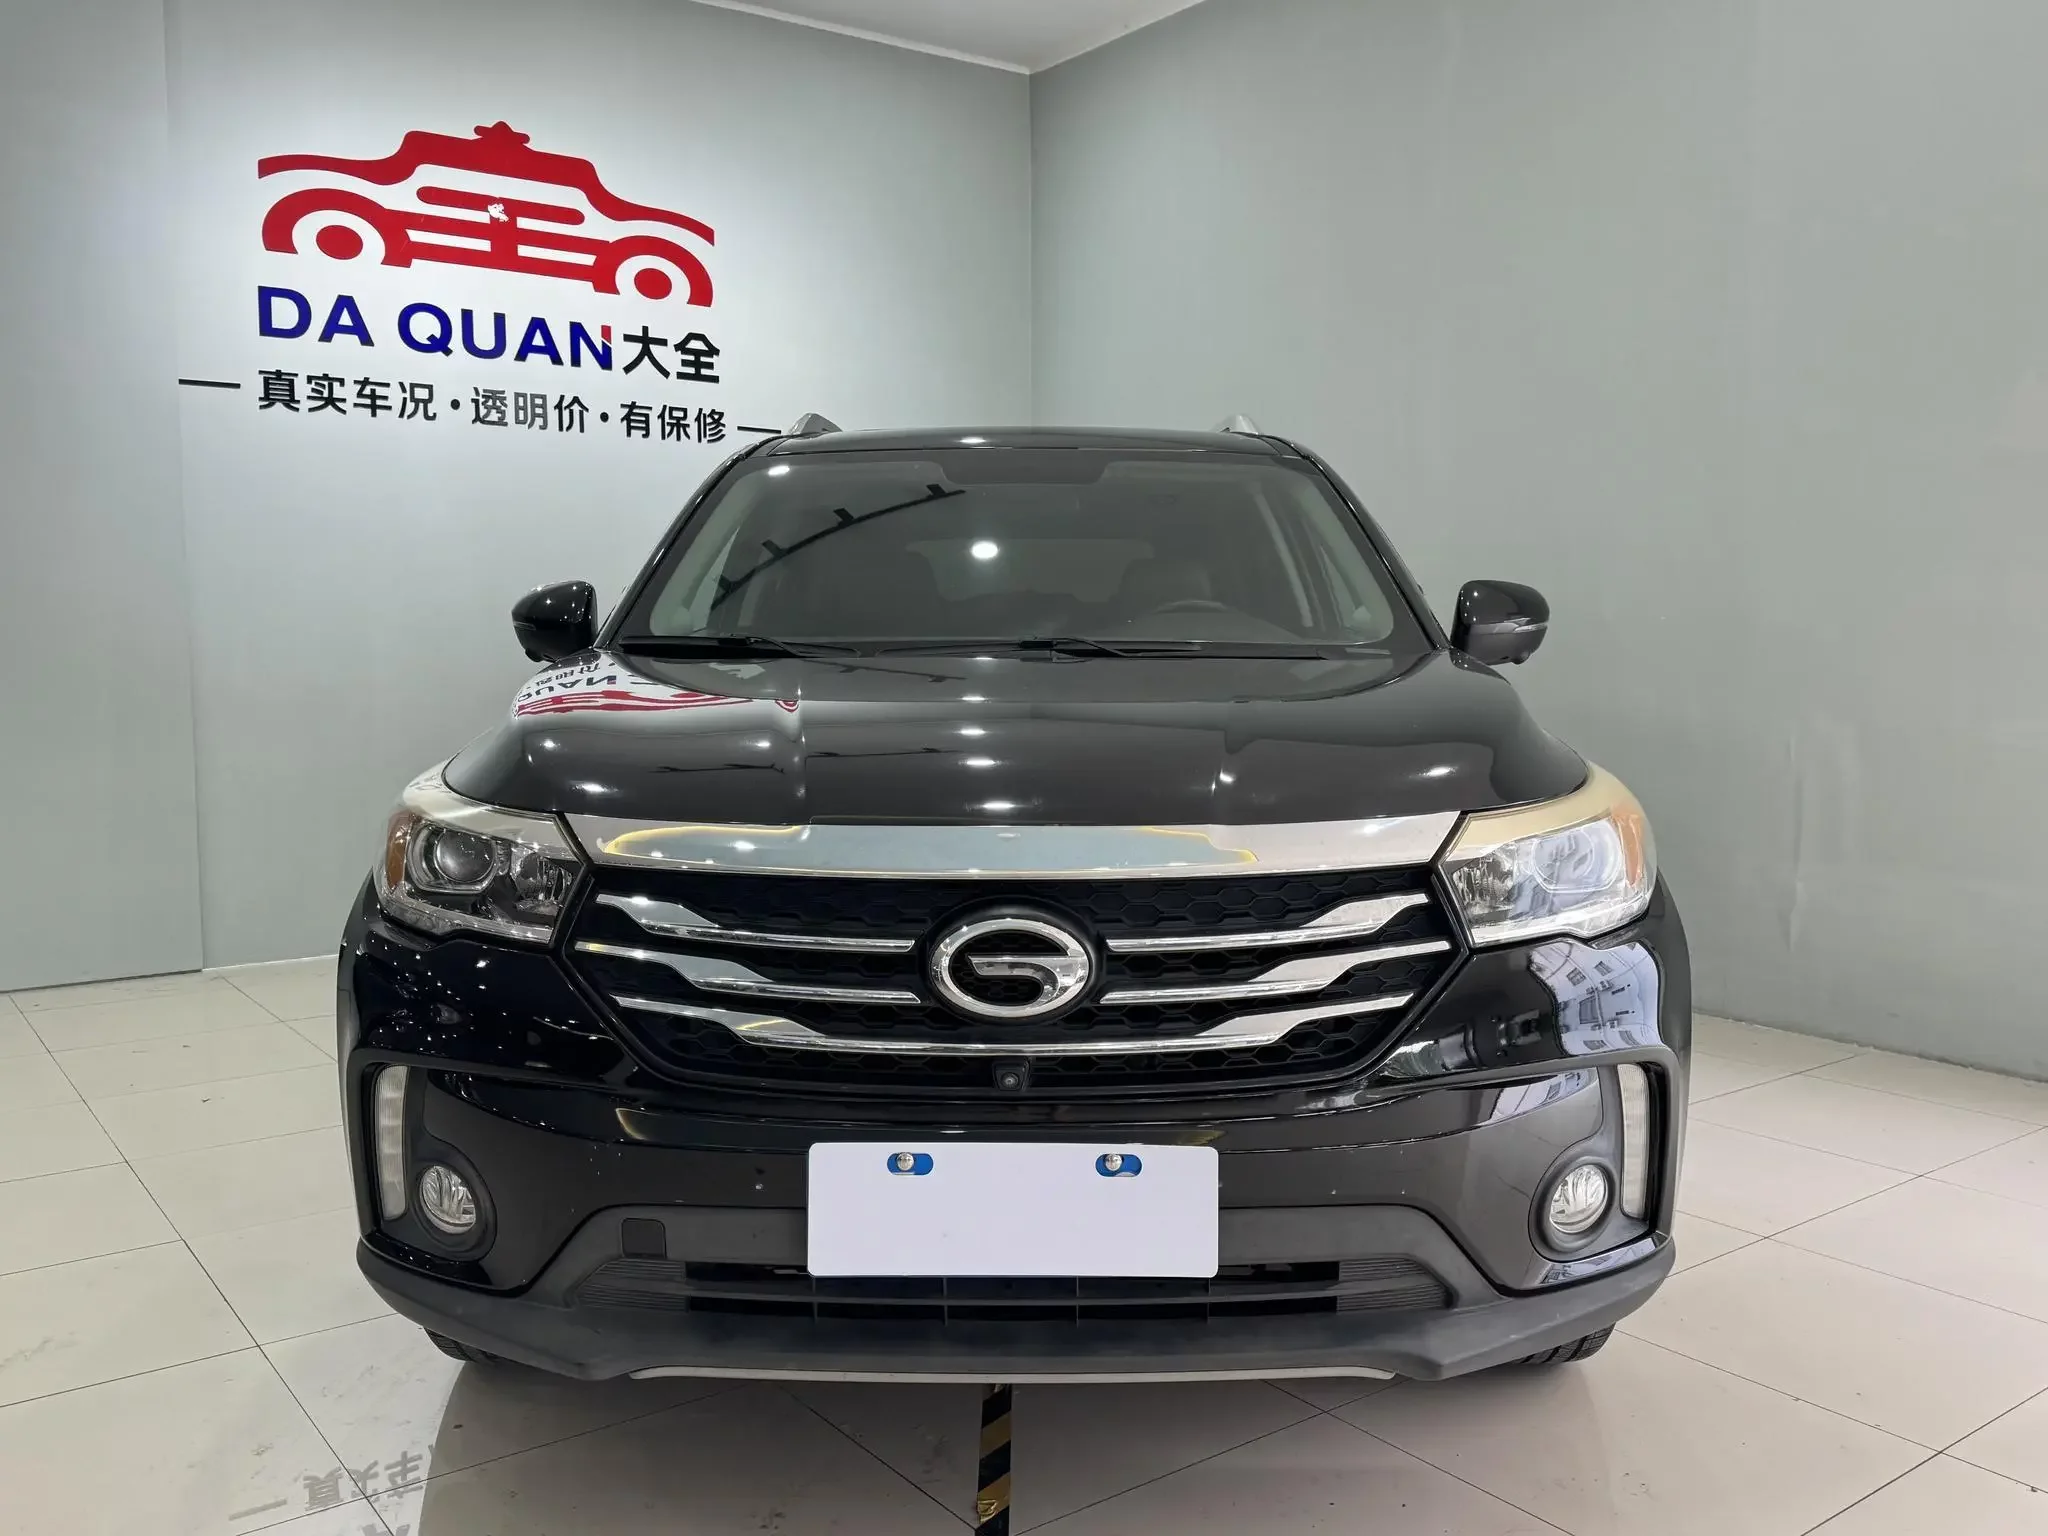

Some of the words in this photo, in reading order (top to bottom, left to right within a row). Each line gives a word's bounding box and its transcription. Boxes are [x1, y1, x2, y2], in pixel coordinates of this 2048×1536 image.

[257, 285, 375, 347] DA
[397, 302, 613, 371] QUAN
[622, 325, 721, 384] 大全
